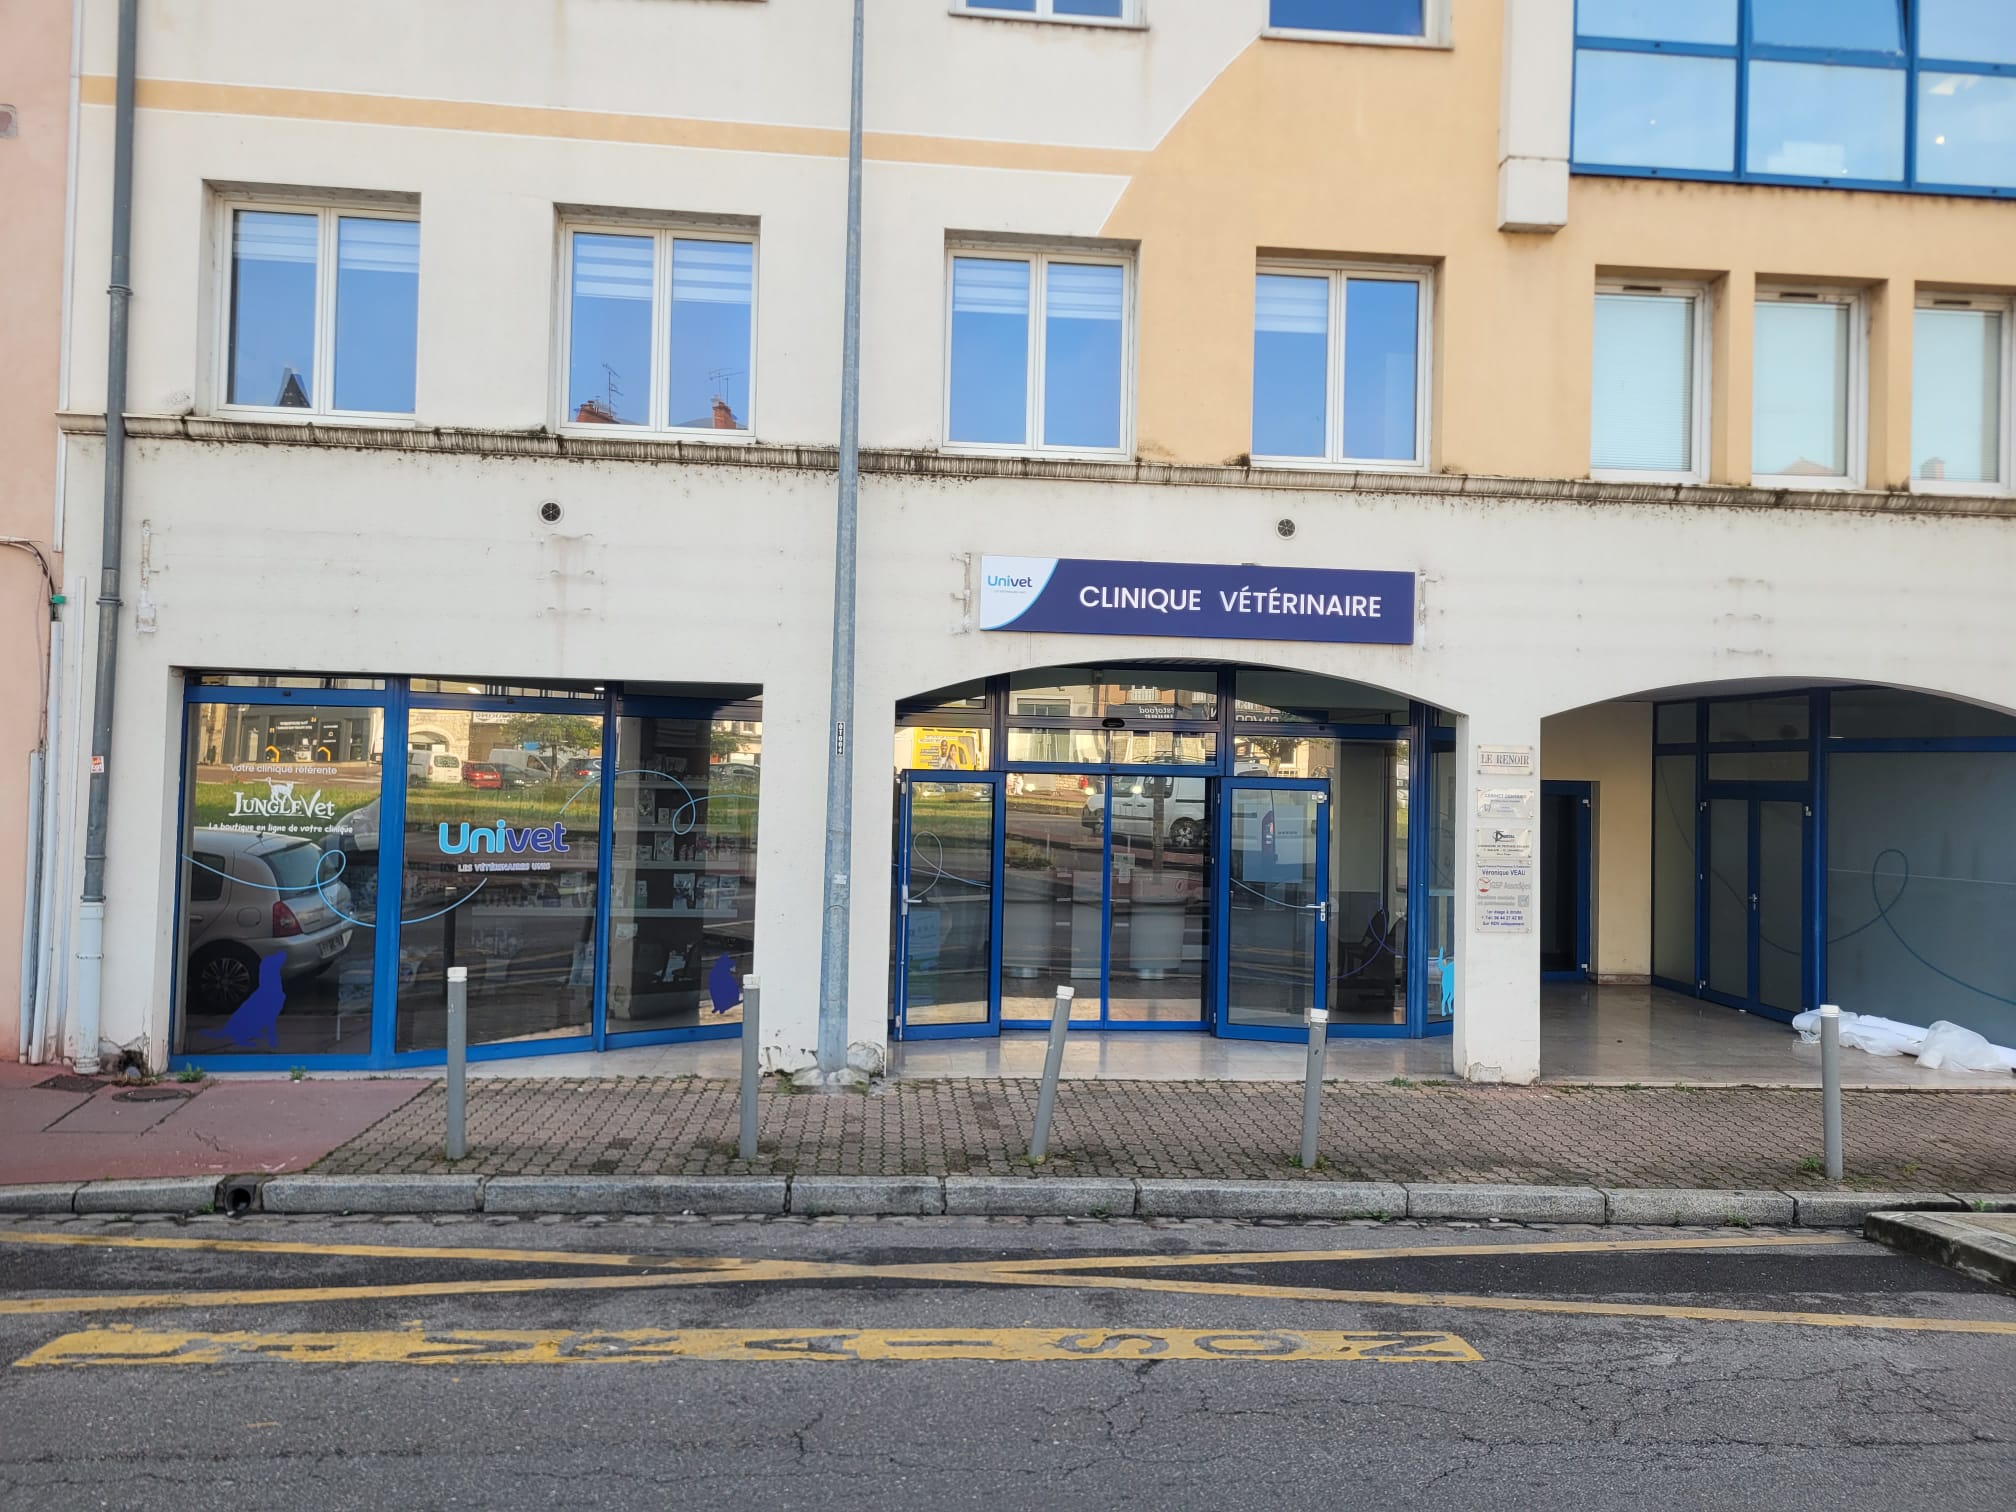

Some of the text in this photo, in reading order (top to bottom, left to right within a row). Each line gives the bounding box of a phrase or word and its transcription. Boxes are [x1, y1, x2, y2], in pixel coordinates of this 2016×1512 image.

[987, 574, 1033, 589] Univet
[1079, 584, 1383, 619] CLINIQUE VÉTÉRINAIRE
[1480, 753, 1530, 766] LE RENOIR
[256, 765, 293, 776] clinique
[295, 765, 338, 775] référente
[208, 822, 354, 835] La boutique en ligne de votre clinique
[438, 818, 571, 855] Univet
[457, 863, 473, 873] LES
